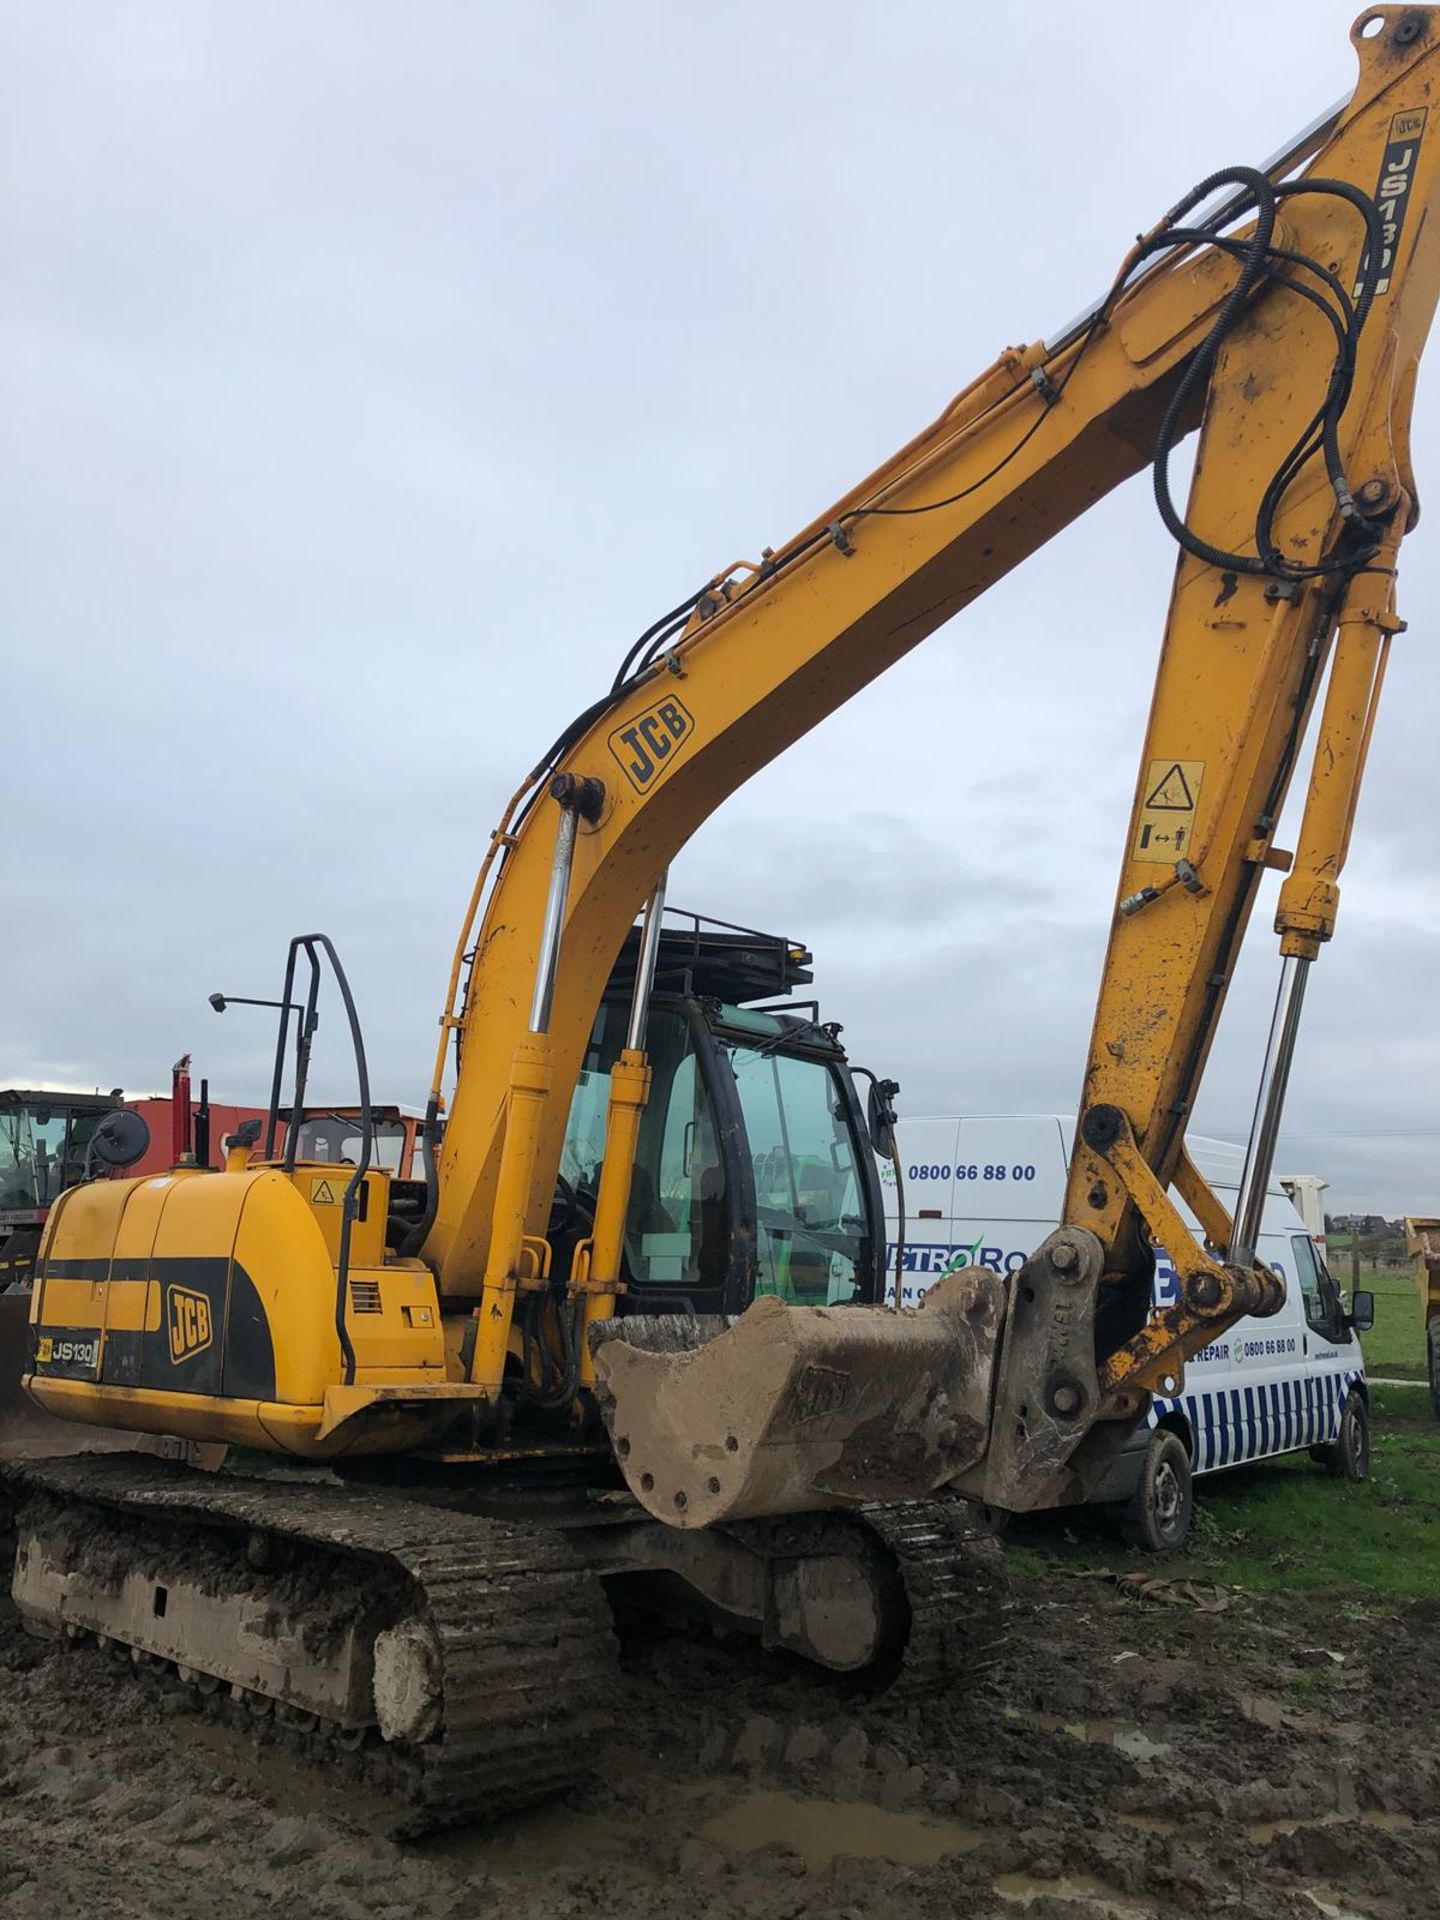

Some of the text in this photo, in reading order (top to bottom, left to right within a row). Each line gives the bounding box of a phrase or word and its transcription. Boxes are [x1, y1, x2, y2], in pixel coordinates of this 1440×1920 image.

[620, 703, 686, 784] JCB
[909, 1165, 1036, 1181] 0800 66 88 00
[172, 1293, 210, 1355] JCB
[52, 1342, 93, 1362] JS130
[1243, 1341, 1265, 1357] 0800
[1265, 1340, 1276, 1355] 66
[1276, 1339, 1287, 1354] 88
[1286, 1338, 1296, 1352] 00
